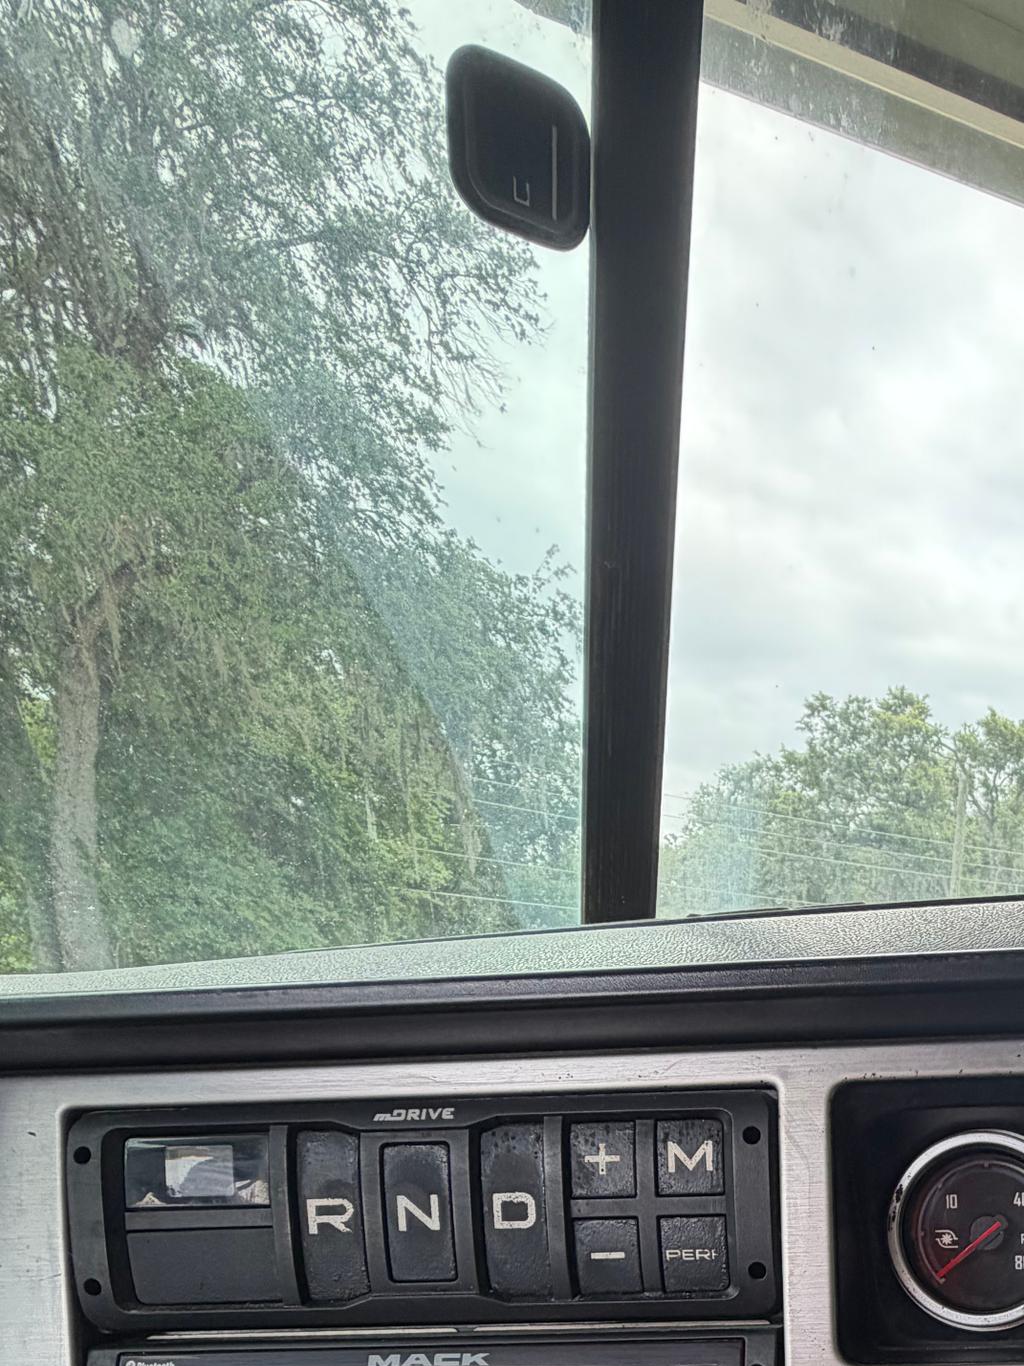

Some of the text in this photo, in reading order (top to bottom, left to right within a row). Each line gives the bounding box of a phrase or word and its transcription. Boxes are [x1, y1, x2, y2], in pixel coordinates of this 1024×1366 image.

[373, 1107, 455, 1121] mDRIVE
[667, 1140, 713, 1173] M
[307, 1198, 354, 1234] R
[396, 1194, 441, 1232] N
[492, 1192, 536, 1229] D
[946, 1194, 958, 1209] 10
